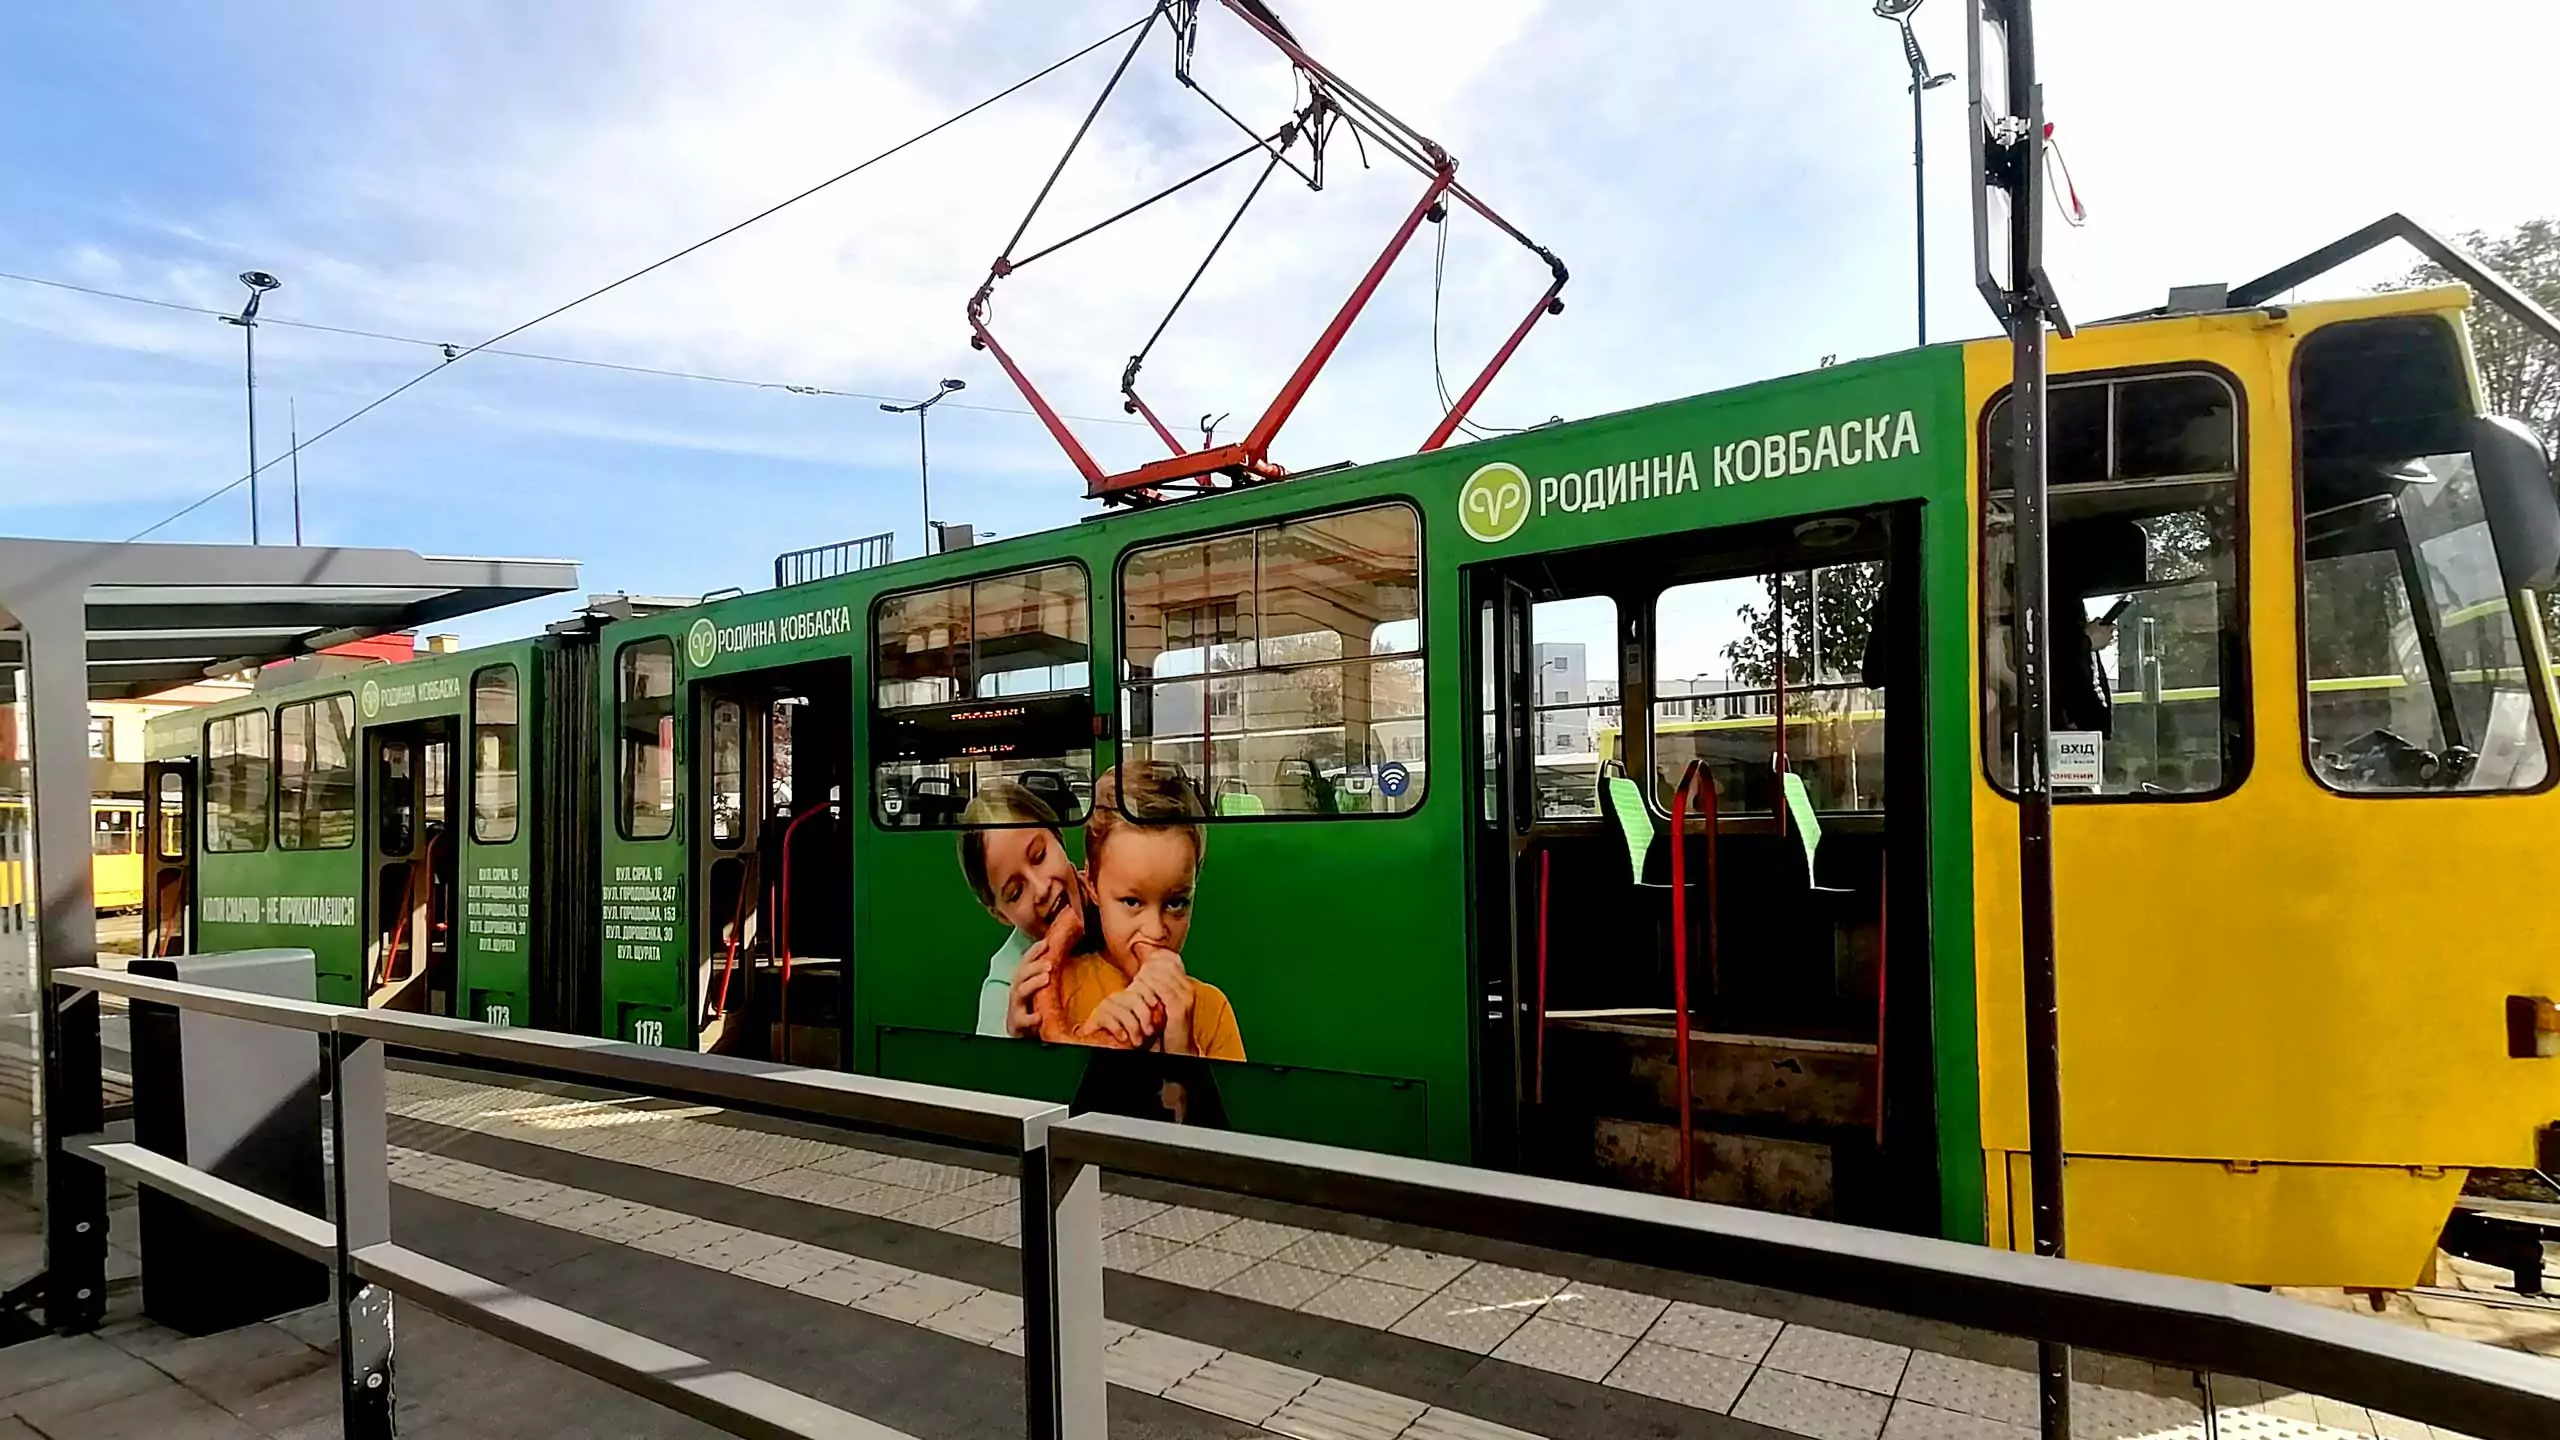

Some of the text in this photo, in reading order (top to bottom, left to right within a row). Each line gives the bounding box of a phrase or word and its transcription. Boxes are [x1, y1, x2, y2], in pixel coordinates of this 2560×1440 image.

[1539, 410, 1921, 518] РОДИННА КОВБАСКА
[717, 606, 851, 654] РОДИННА КОВБАСКА
[381, 683, 417, 708] РОДИННА
[2060, 744, 2095, 756] ВХІД
[654, 866, 663, 881] 16
[663, 887, 676, 901] 247
[266, 897, 279, 924] НЕ
[279, 897, 355, 927] ПРИКИДАЄШСЯ
[663, 906, 676, 921] 153
[663, 926, 673, 941] 30
[486, 1004, 511, 1027] 1173
[634, 1019, 663, 1047] 1173
